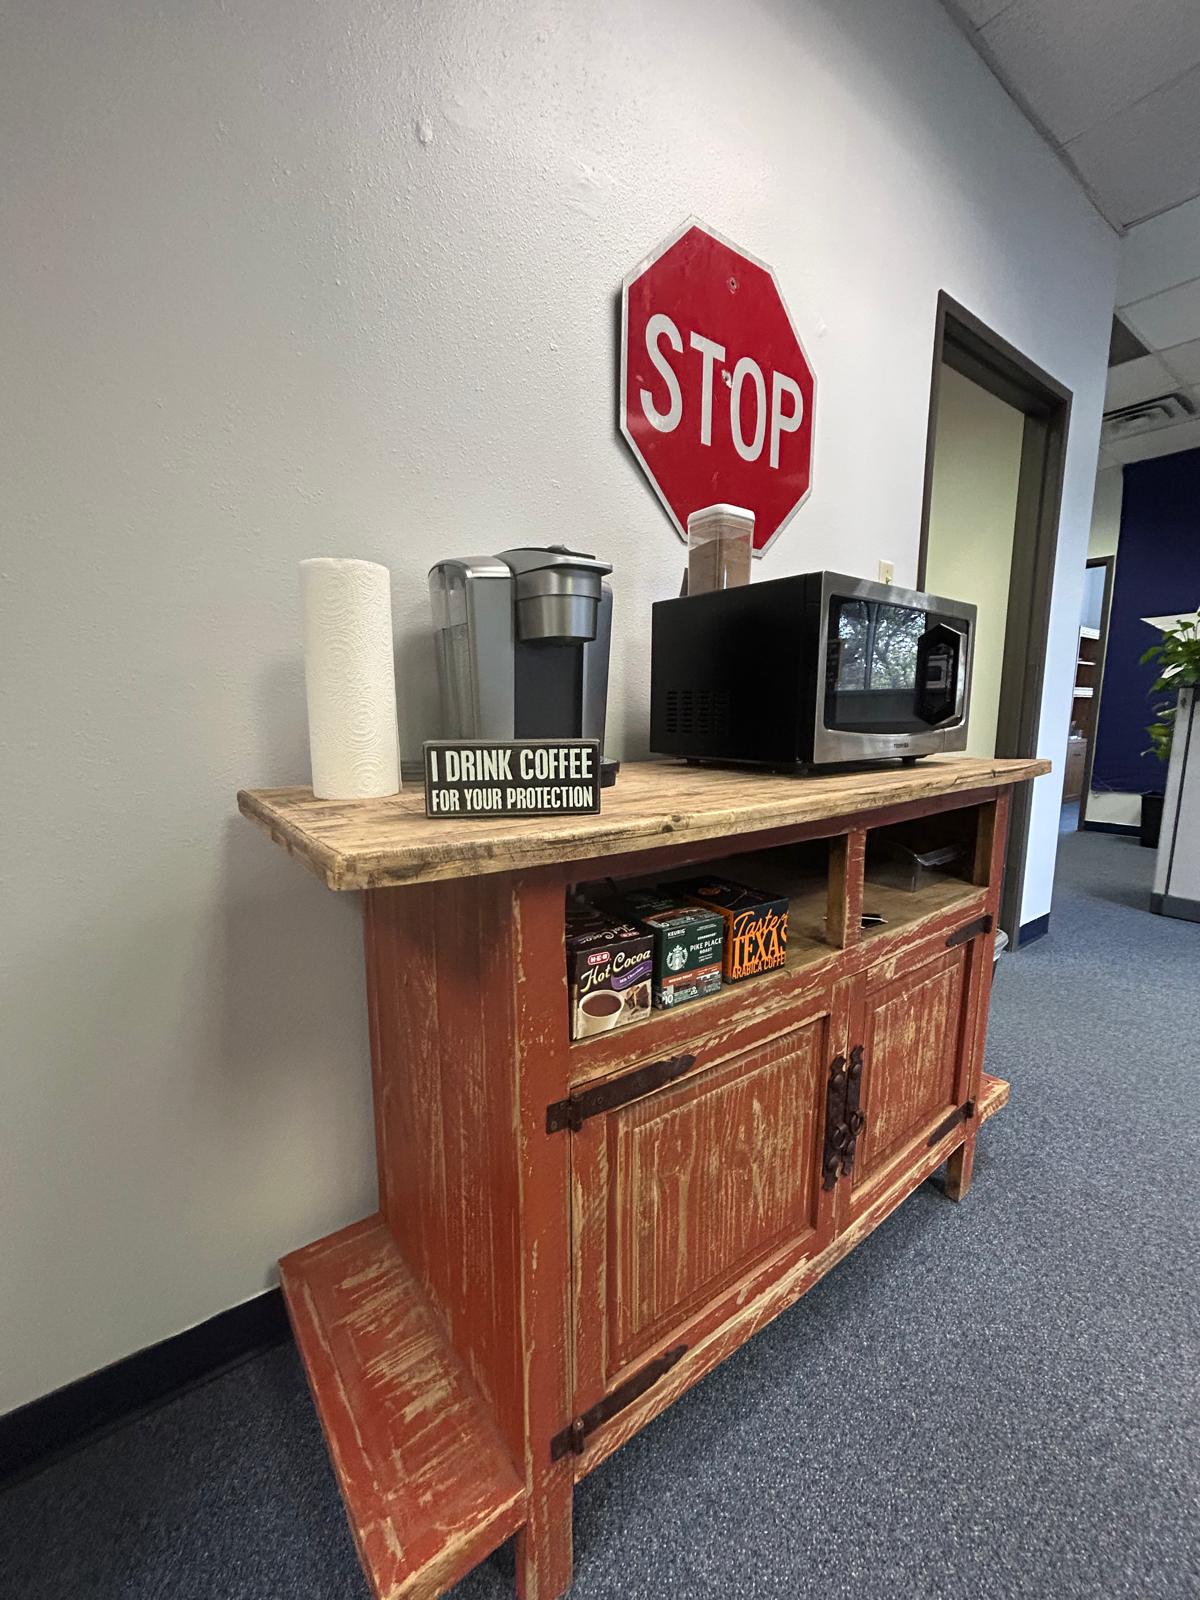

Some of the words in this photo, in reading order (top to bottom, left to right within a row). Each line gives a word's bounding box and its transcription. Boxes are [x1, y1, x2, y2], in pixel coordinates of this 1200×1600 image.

[640, 313, 803, 469] STOP
[431, 751, 438, 782] I
[445, 750, 513, 782] DRINK
[520, 748, 593, 780] COFFEE
[432, 789, 460, 812] FOR
[464, 788, 502, 811] YOUR
[506, 786, 593, 809] PROTECTION
[734, 908, 779, 937] Taste
[690, 943, 703, 952] PIKE
[704, 937, 723, 948] PLACE
[580, 964, 612, 993] Hot
[612, 950, 651, 973] Cocoa
